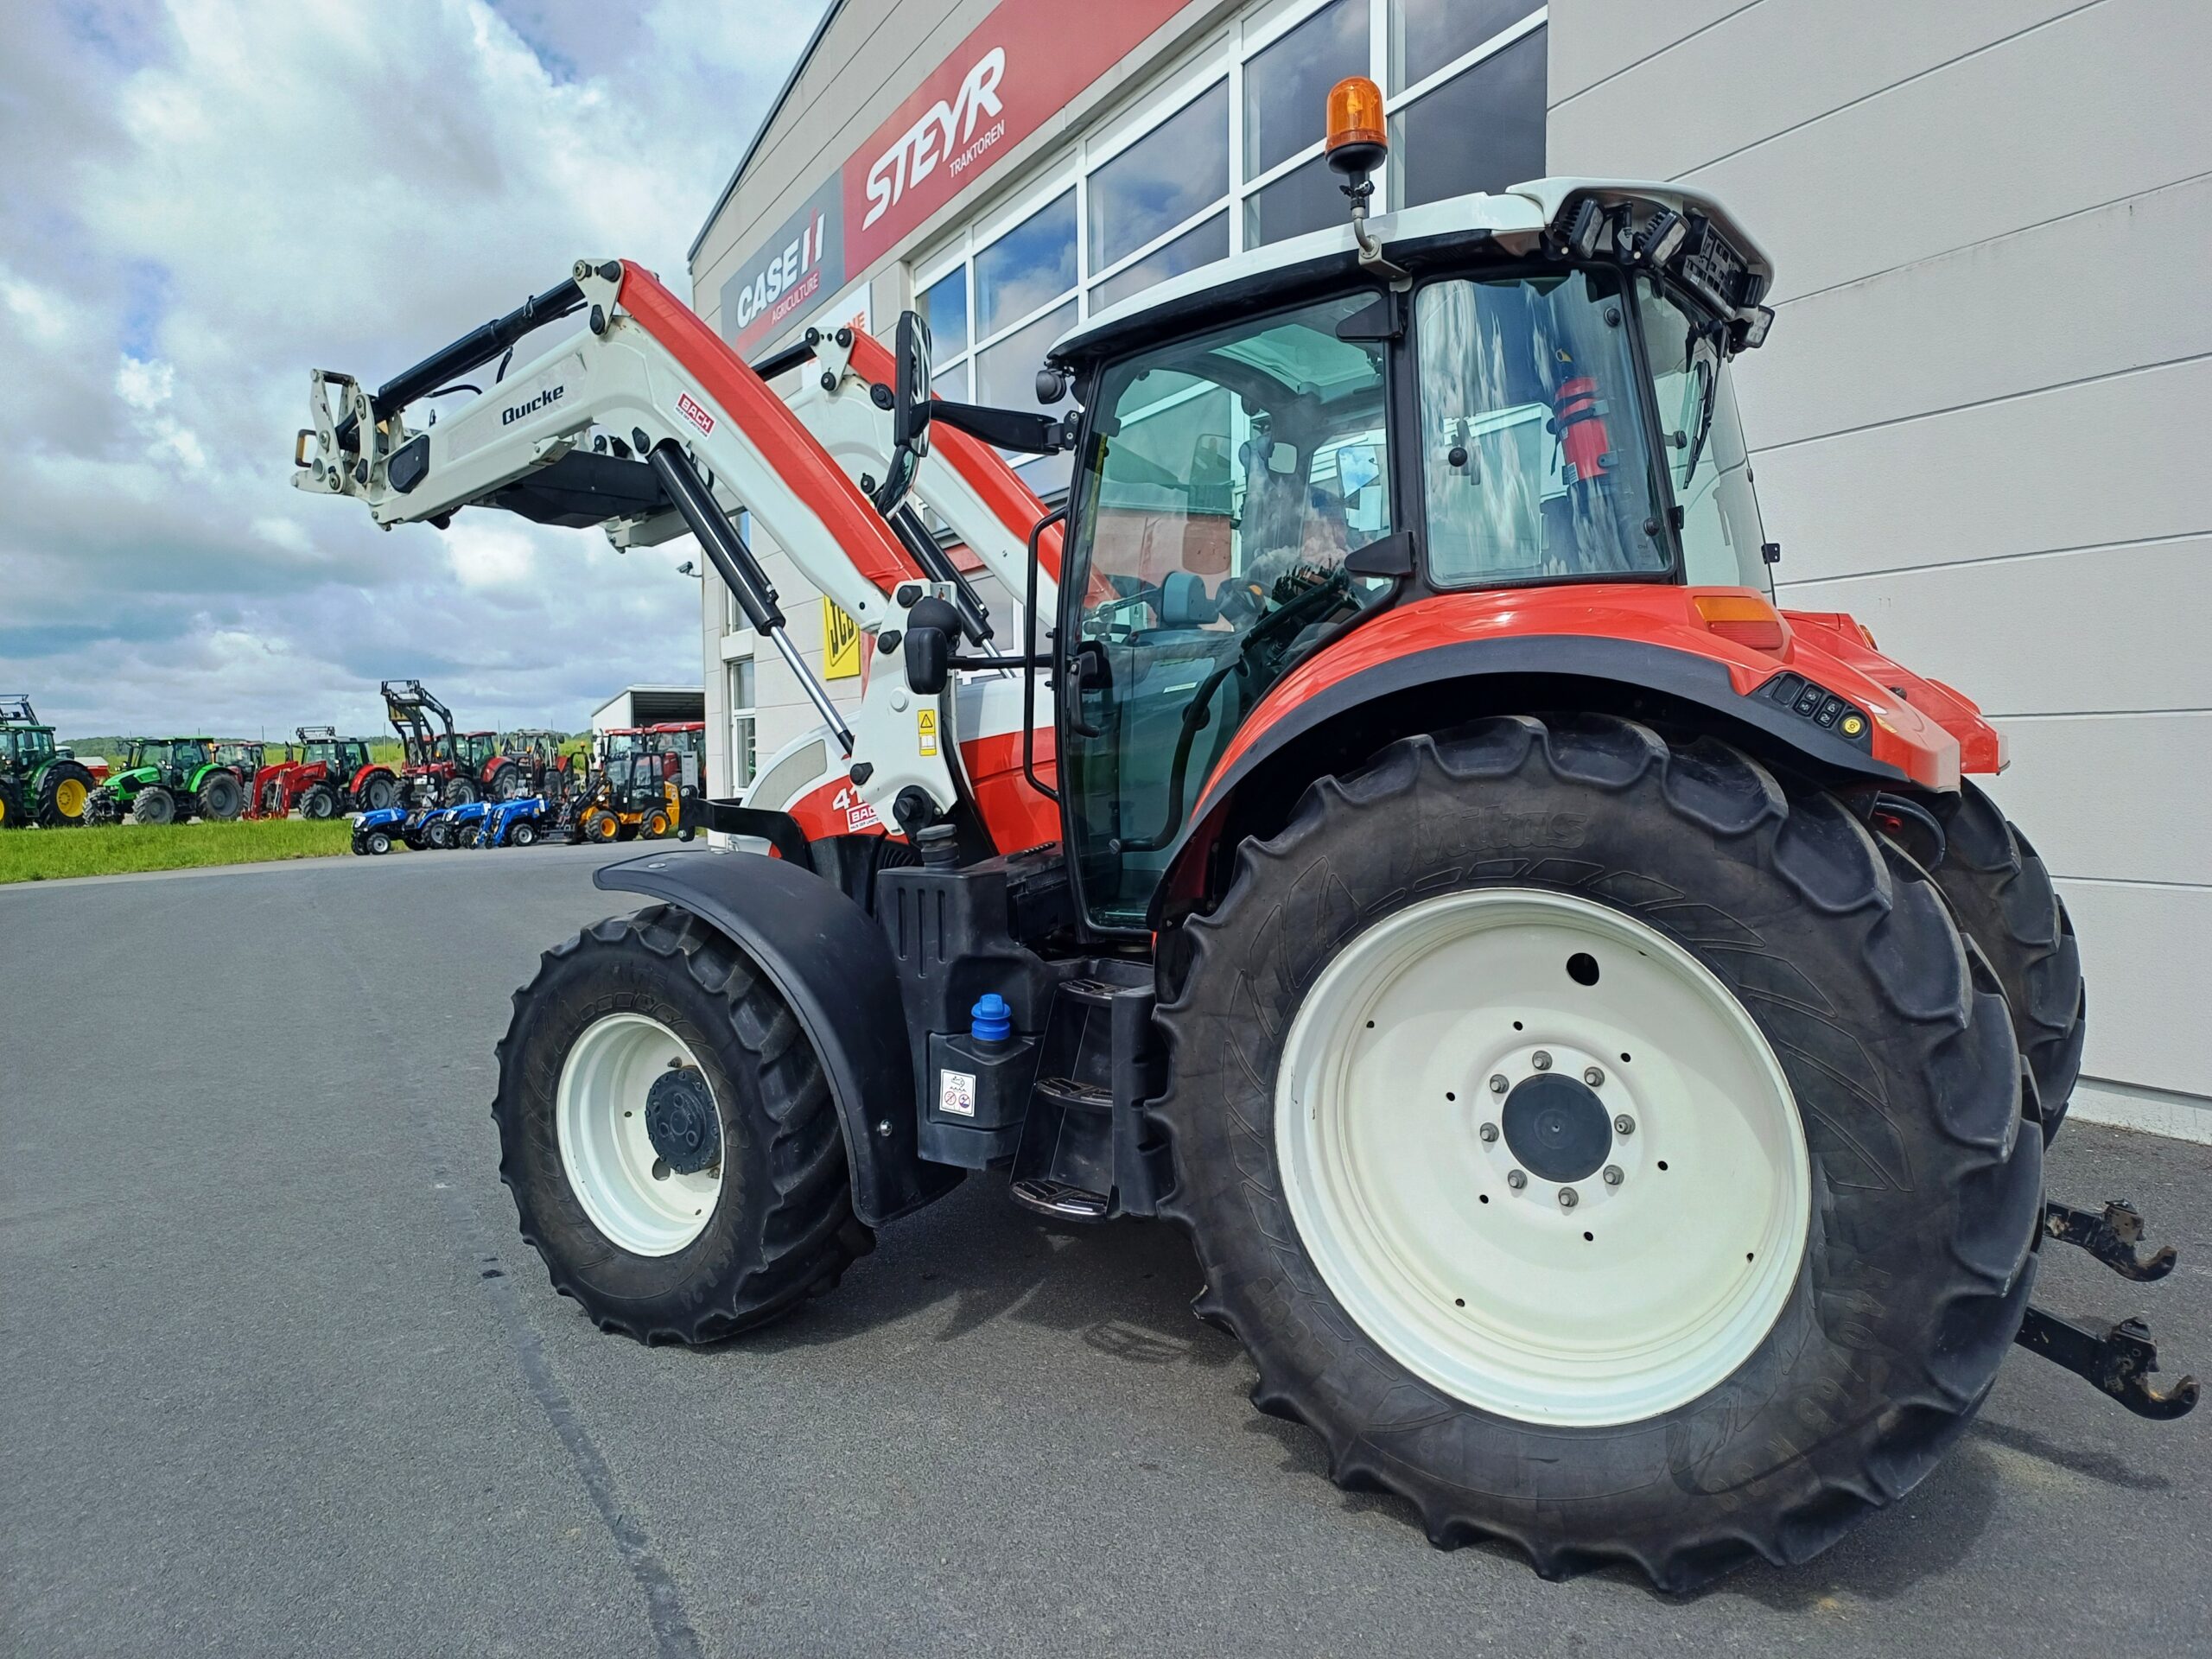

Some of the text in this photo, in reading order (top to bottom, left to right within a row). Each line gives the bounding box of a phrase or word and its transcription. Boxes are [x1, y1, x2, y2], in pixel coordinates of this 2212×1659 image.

[861, 47, 1006, 232] STEYR
[950, 119, 1005, 178] TRAKTOREN
[737, 238, 799, 329] CASE
[771, 272, 819, 326] AGRICULTURE
[502, 385, 564, 426] Quicke
[681, 397, 712, 430] BACH
[851, 805, 877, 823] BAC
